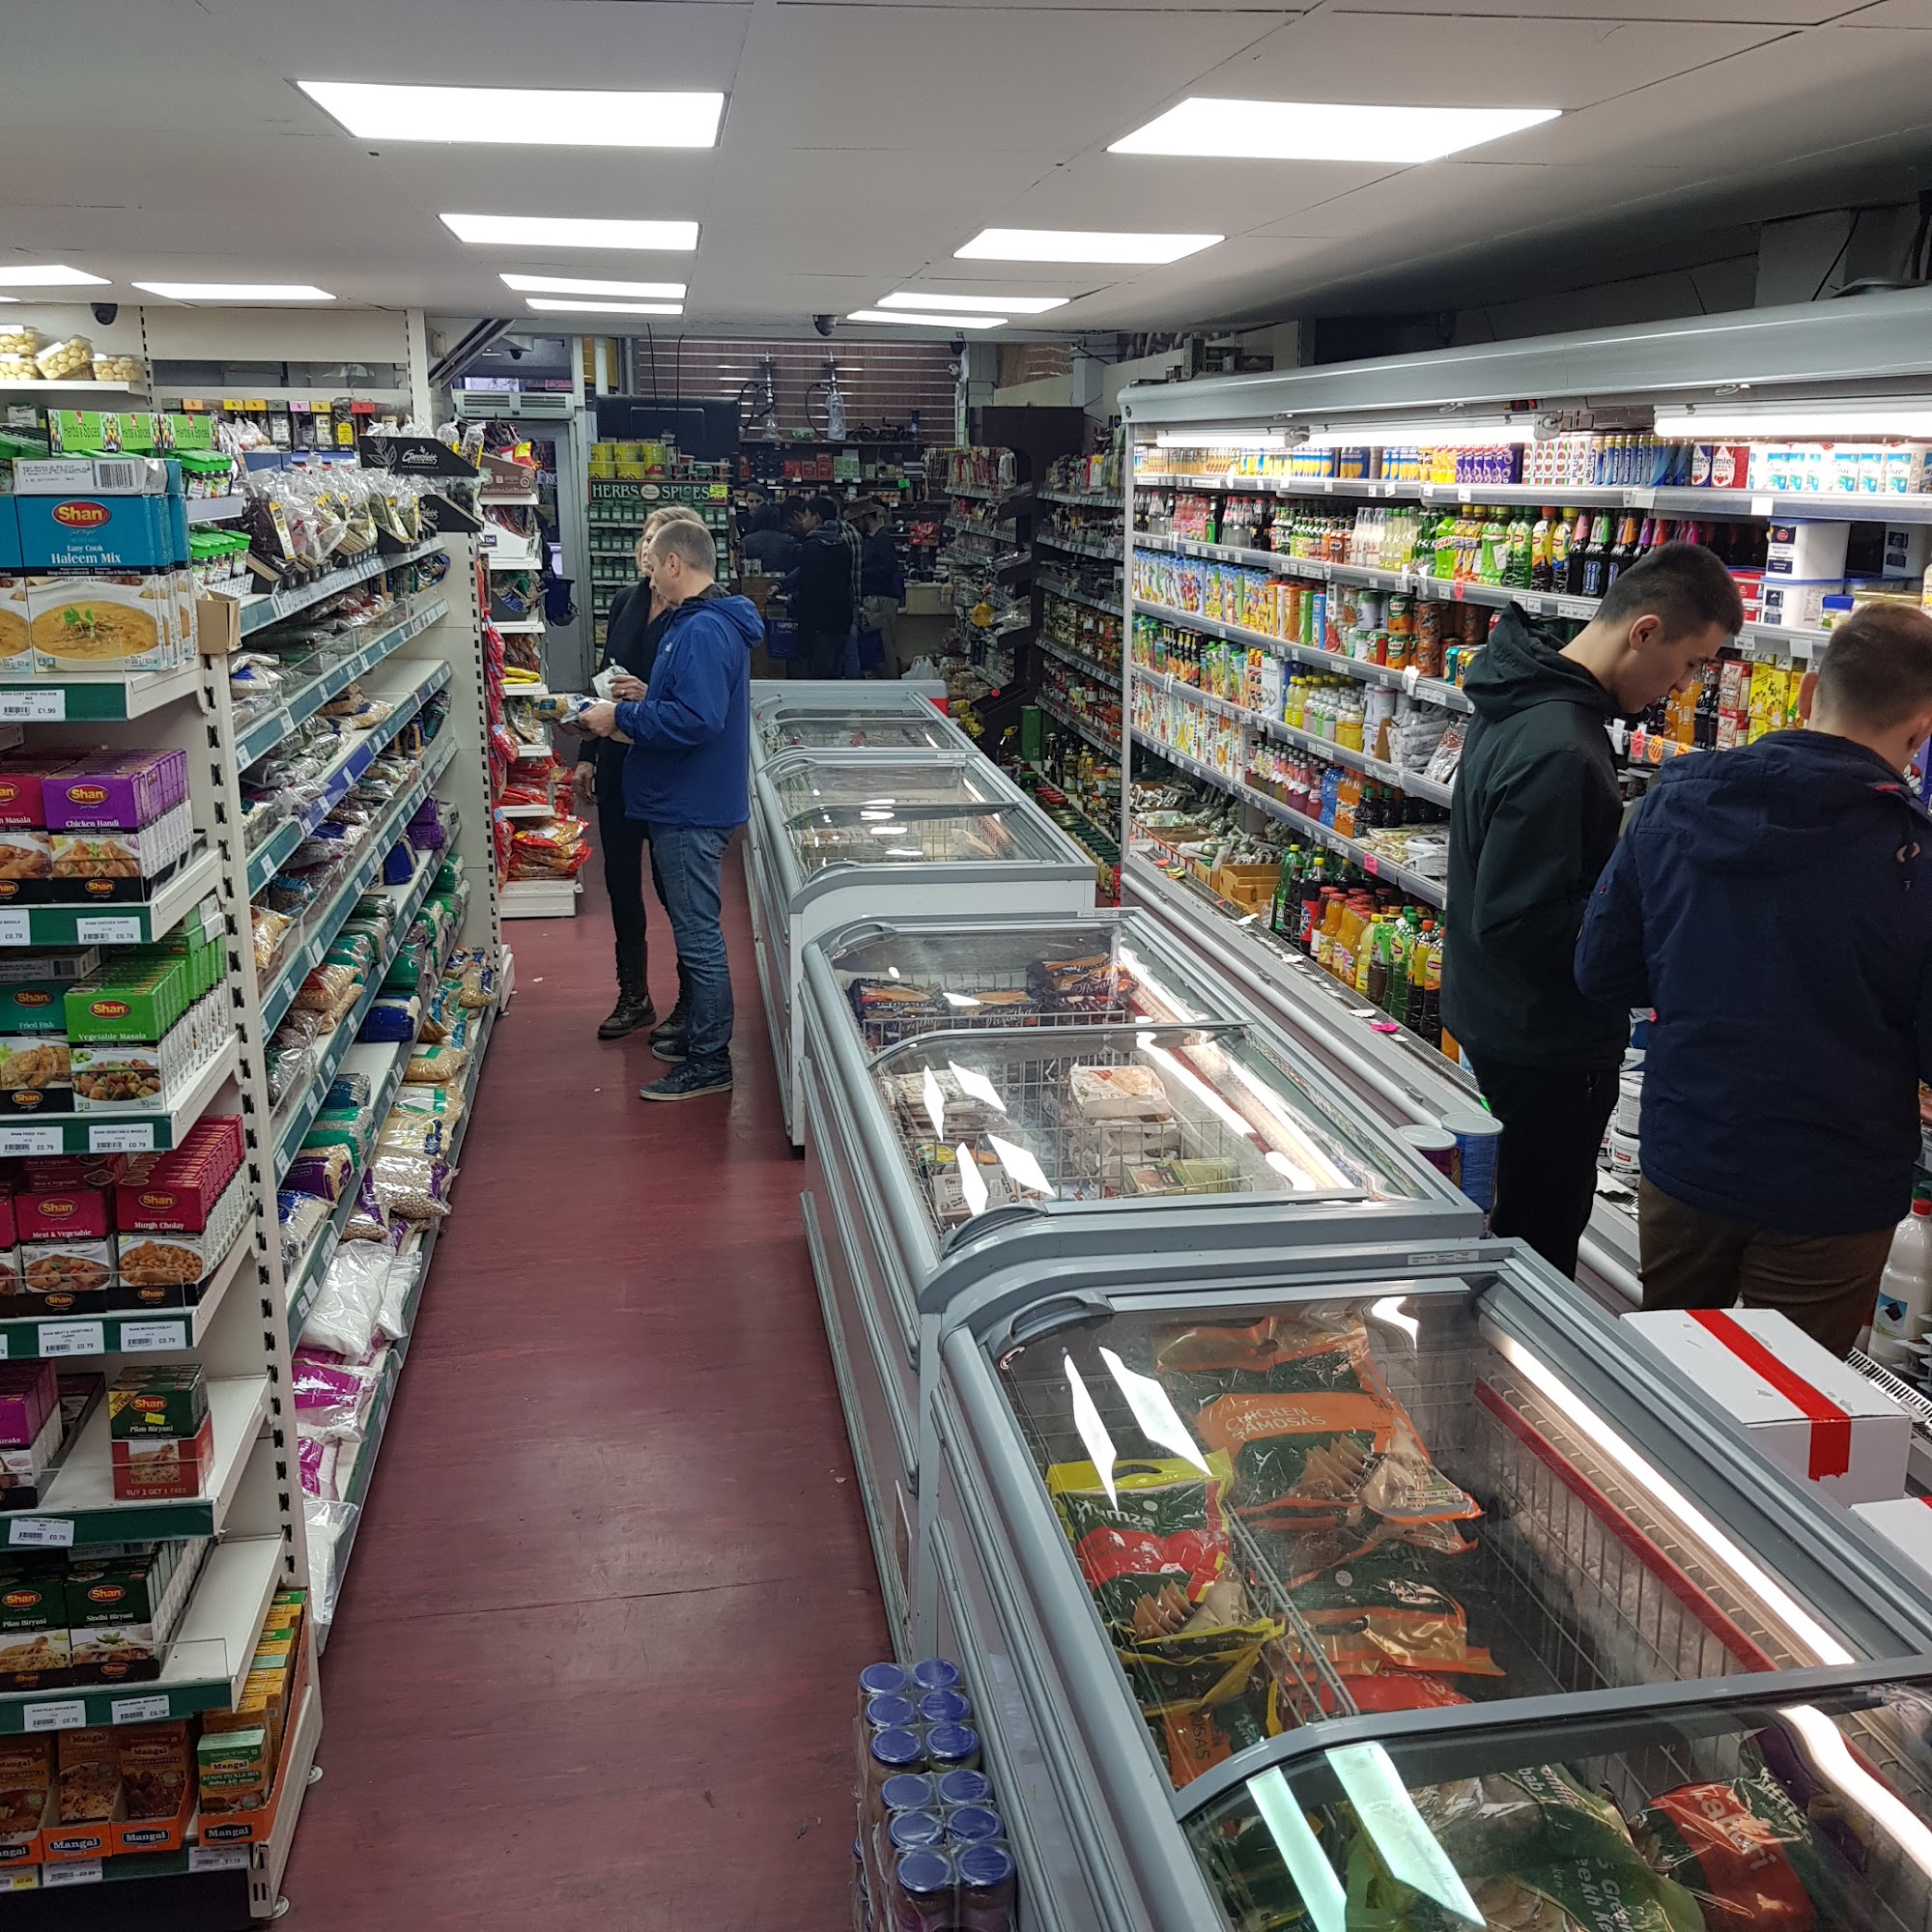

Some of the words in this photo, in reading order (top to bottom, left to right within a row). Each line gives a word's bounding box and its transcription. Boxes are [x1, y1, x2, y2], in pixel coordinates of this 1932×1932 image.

[592, 484, 639, 499] HERBS
[662, 486, 710, 500] SPIES
[58, 506, 104, 522] Shan
[67, 545, 84, 554] Easy
[85, 544, 104, 553] Cook
[51, 553, 98, 565] Haleem
[101, 553, 122, 564] Mix
[0, 787, 14, 798] an
[71, 788, 104, 800] Shan
[66, 819, 95, 828] Chicken
[98, 819, 120, 828] Handi
[87, 881, 113, 891] Shan
[17, 992, 48, 1003] Shan
[93, 1004, 126, 1014] Shan
[78, 1033, 118, 1041] Vegetable
[14, 1094, 40, 1102] Shan
[144, 1195, 174, 1206] Shan
[43, 1203, 73, 1212] Shan
[134, 1222, 157, 1231] Murgh
[159, 1222, 185, 1231] Cholay
[57, 1229, 92, 1237] Vegetable
[48, 1295, 72, 1304] Shan
[141, 1290, 164, 1298] Shan
[133, 1398, 165, 1409] Shan
[1225, 1406, 1309, 1433] CHICKEN
[1232, 1415, 1327, 1440] SAMOSAS
[6, 1593, 36, 1605] Shan
[92, 1588, 122, 1599] Shan
[86, 1614, 108, 1623] Sindhi
[109, 1611, 133, 1622] Biryani
[23, 1618, 47, 1628] Biryani
[104, 1664, 127, 1674] Shan
[72, 1733, 106, 1743] Mangal
[134, 1747, 167, 1756] Mangal
[213, 1761, 248, 1770] Mangal
[1518, 1766, 1547, 1792] bab
[126, 1831, 167, 1842] Mangal
[208, 1826, 249, 1837] Mangal
[53, 1838, 98, 1850] Mangal
[0, 1847, 27, 1858] ngal
